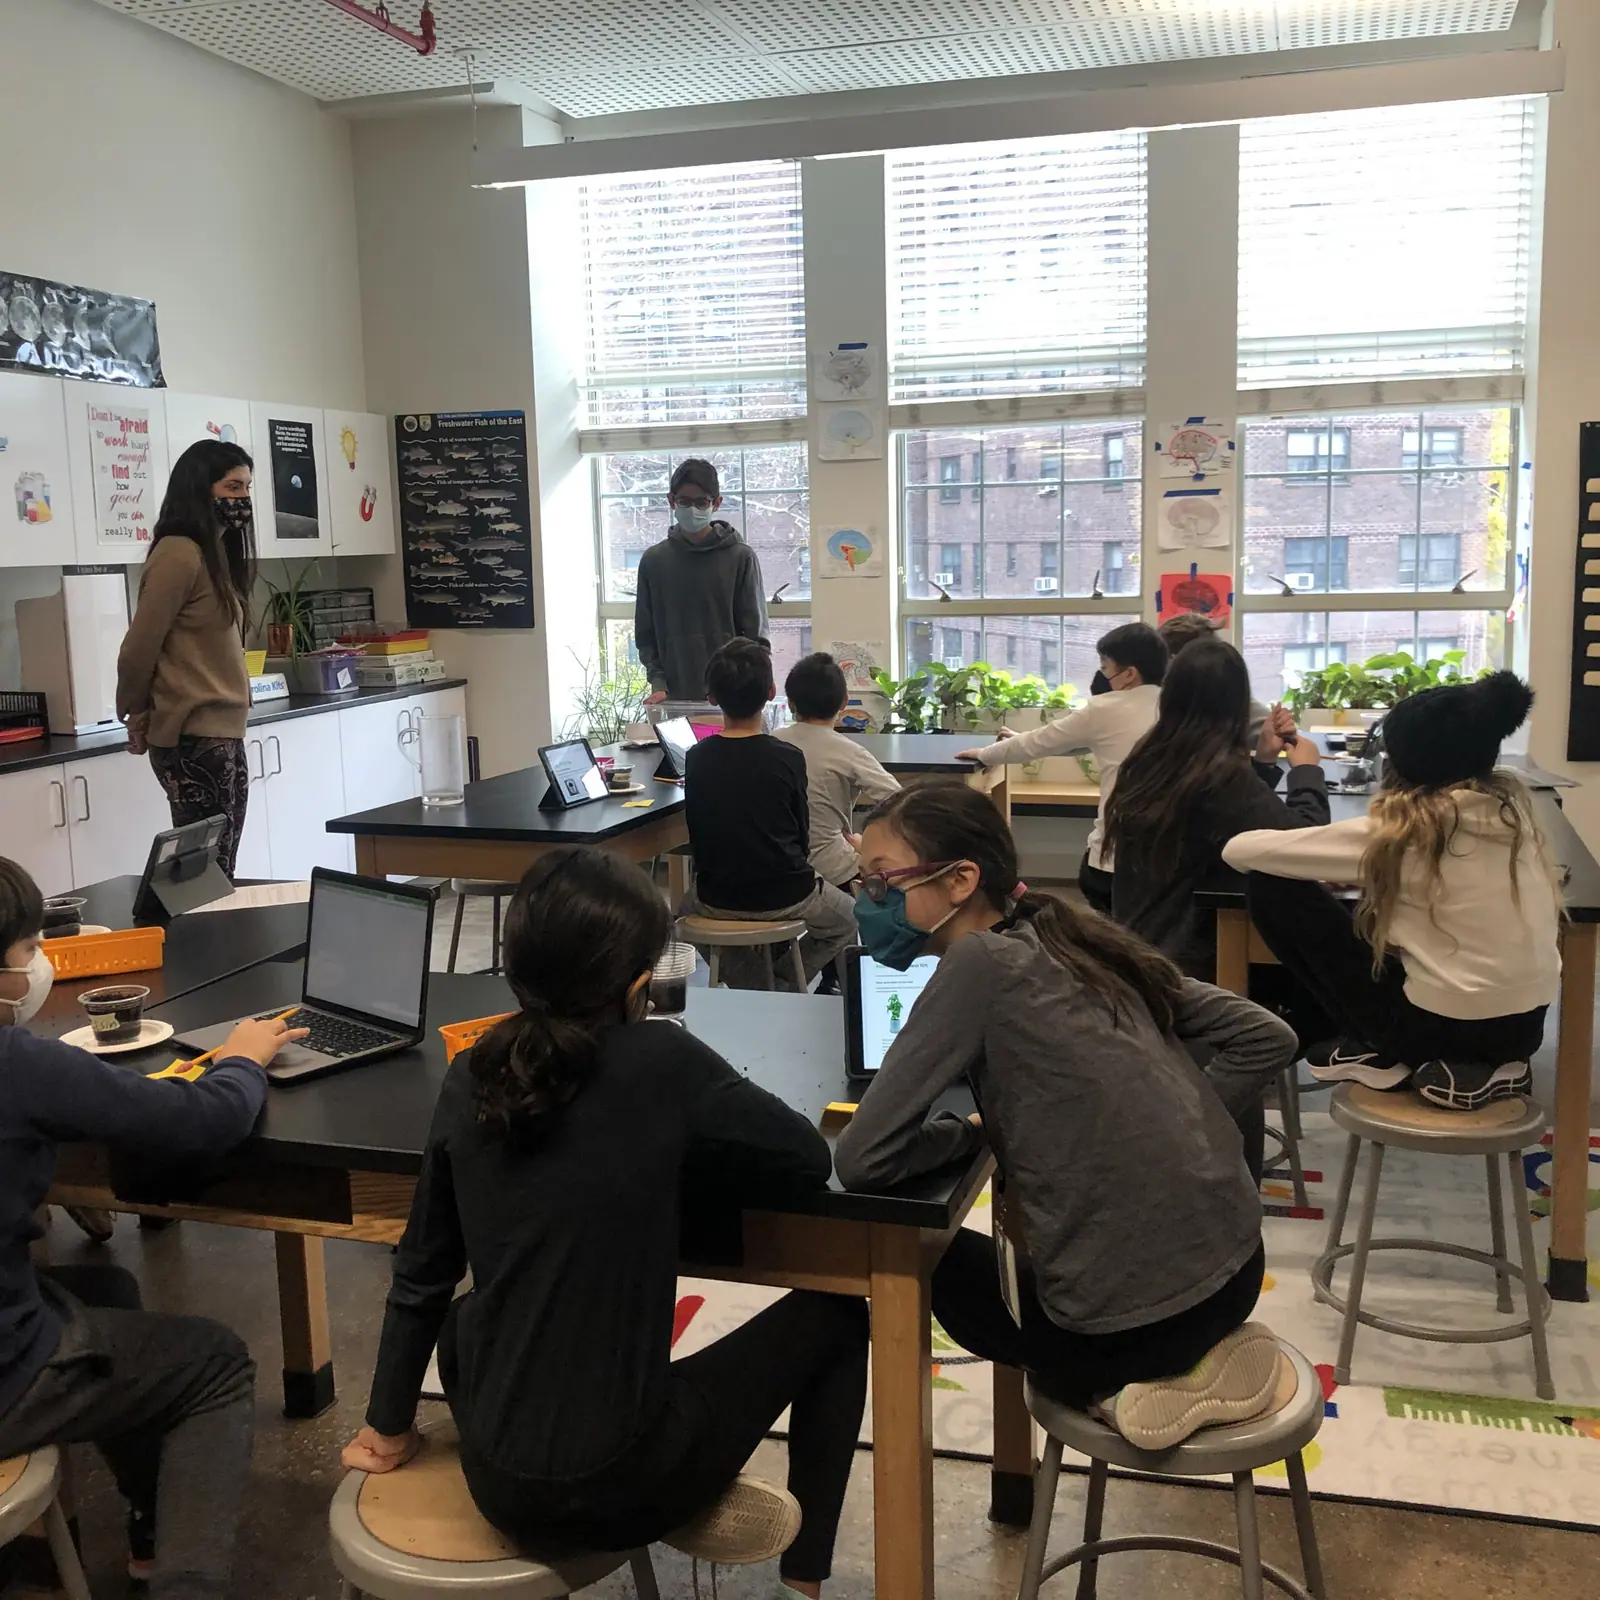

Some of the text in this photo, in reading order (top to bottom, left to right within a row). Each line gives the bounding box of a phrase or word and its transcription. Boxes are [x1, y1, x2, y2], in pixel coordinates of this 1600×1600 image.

[91, 407, 113, 422] Don't
[120, 418, 148, 434] afraid
[438, 420, 474, 428] Freshwater
[96, 430, 104, 439] to
[104, 432, 128, 447] work
[112, 464, 130, 479] find
[133, 471, 147, 479] out
[116, 482, 130, 490] how
[110, 489, 143, 511] good
[117, 511, 144, 520] you can
[105, 527, 133, 538] really
[251, 680, 284, 693] rolina Kits
